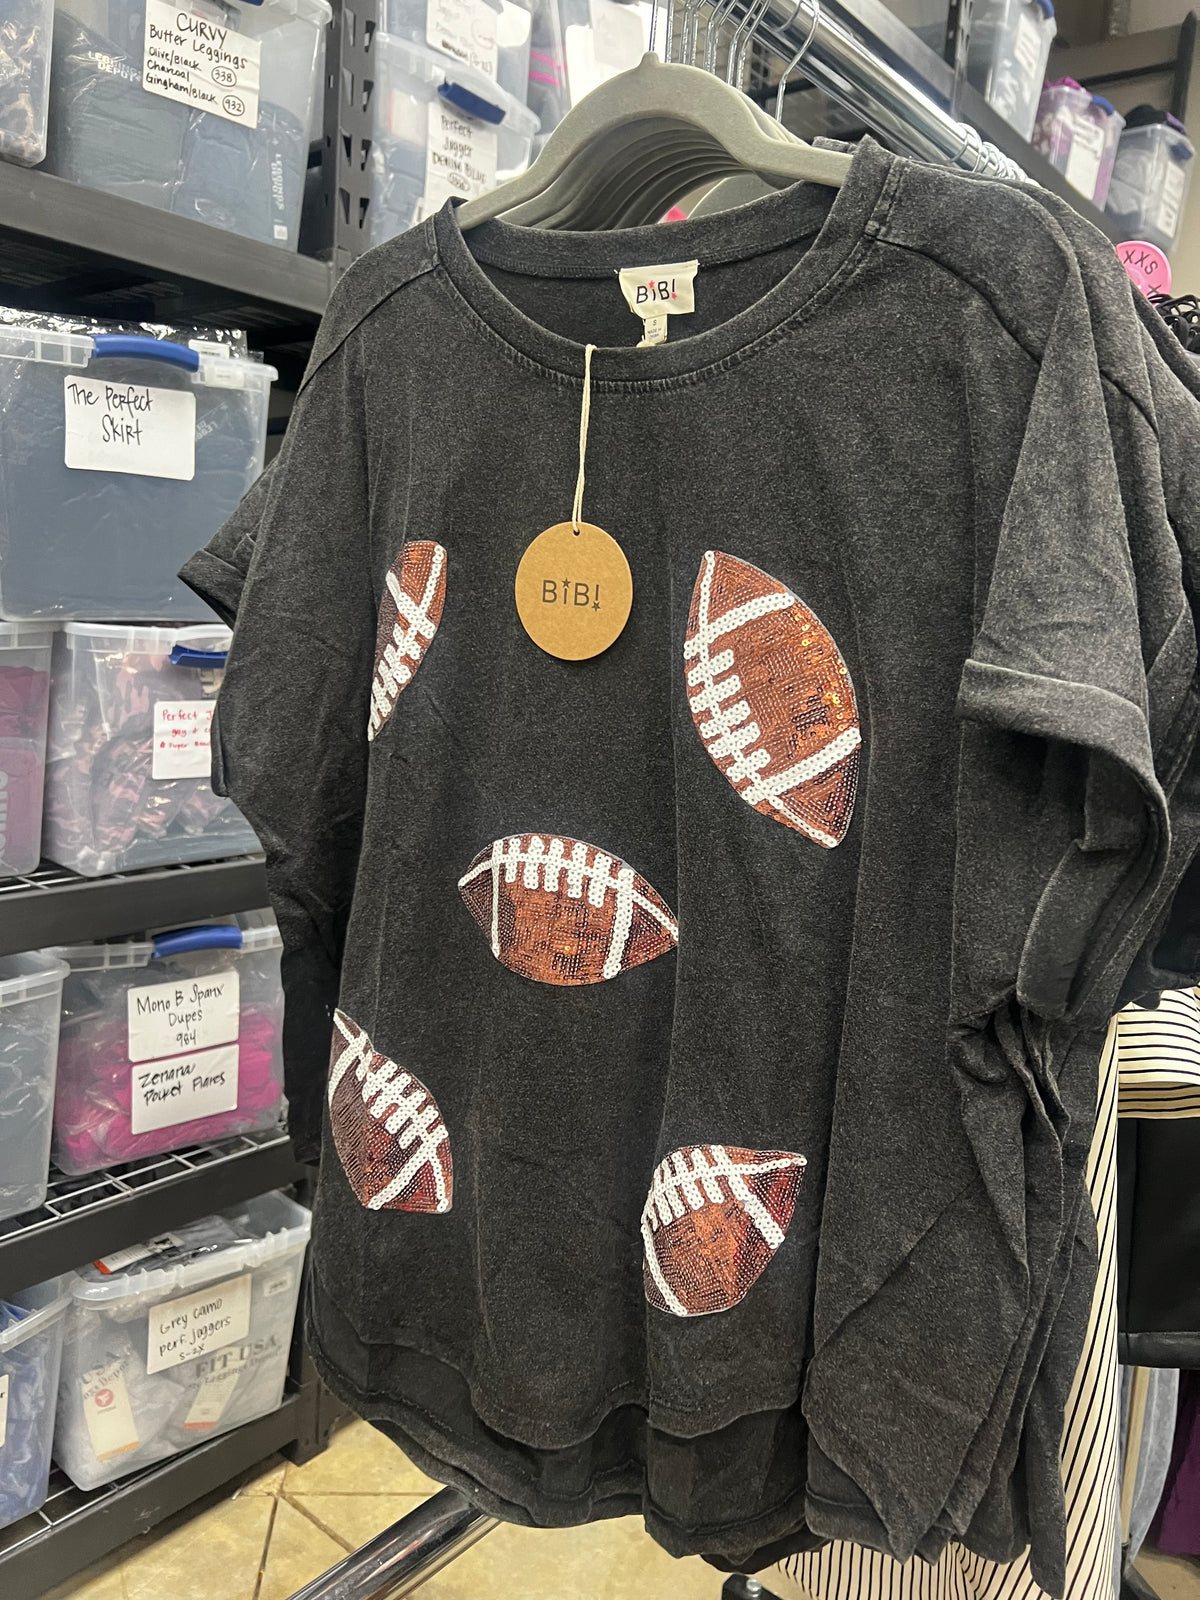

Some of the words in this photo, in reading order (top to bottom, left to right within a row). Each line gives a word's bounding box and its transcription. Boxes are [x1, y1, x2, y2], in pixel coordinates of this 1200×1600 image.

[177, 13, 227, 49] CURVY
[150, 24, 187, 46] Butter
[193, 40, 248, 70] Leggings
[147, 59, 190, 82] Charcoal
[1123, 249, 1158, 275] XXS
[67, 383, 99, 406] The
[162, 709, 197, 721] Perfect
[137, 997, 170, 1015] Mono
[175, 990, 184, 1007] B
[190, 983, 224, 1007] Spanx
[168, 1009, 203, 1030] Dupes
[176, 1029, 197, 1047] 984
[160, 1315, 188, 1334] Grey
